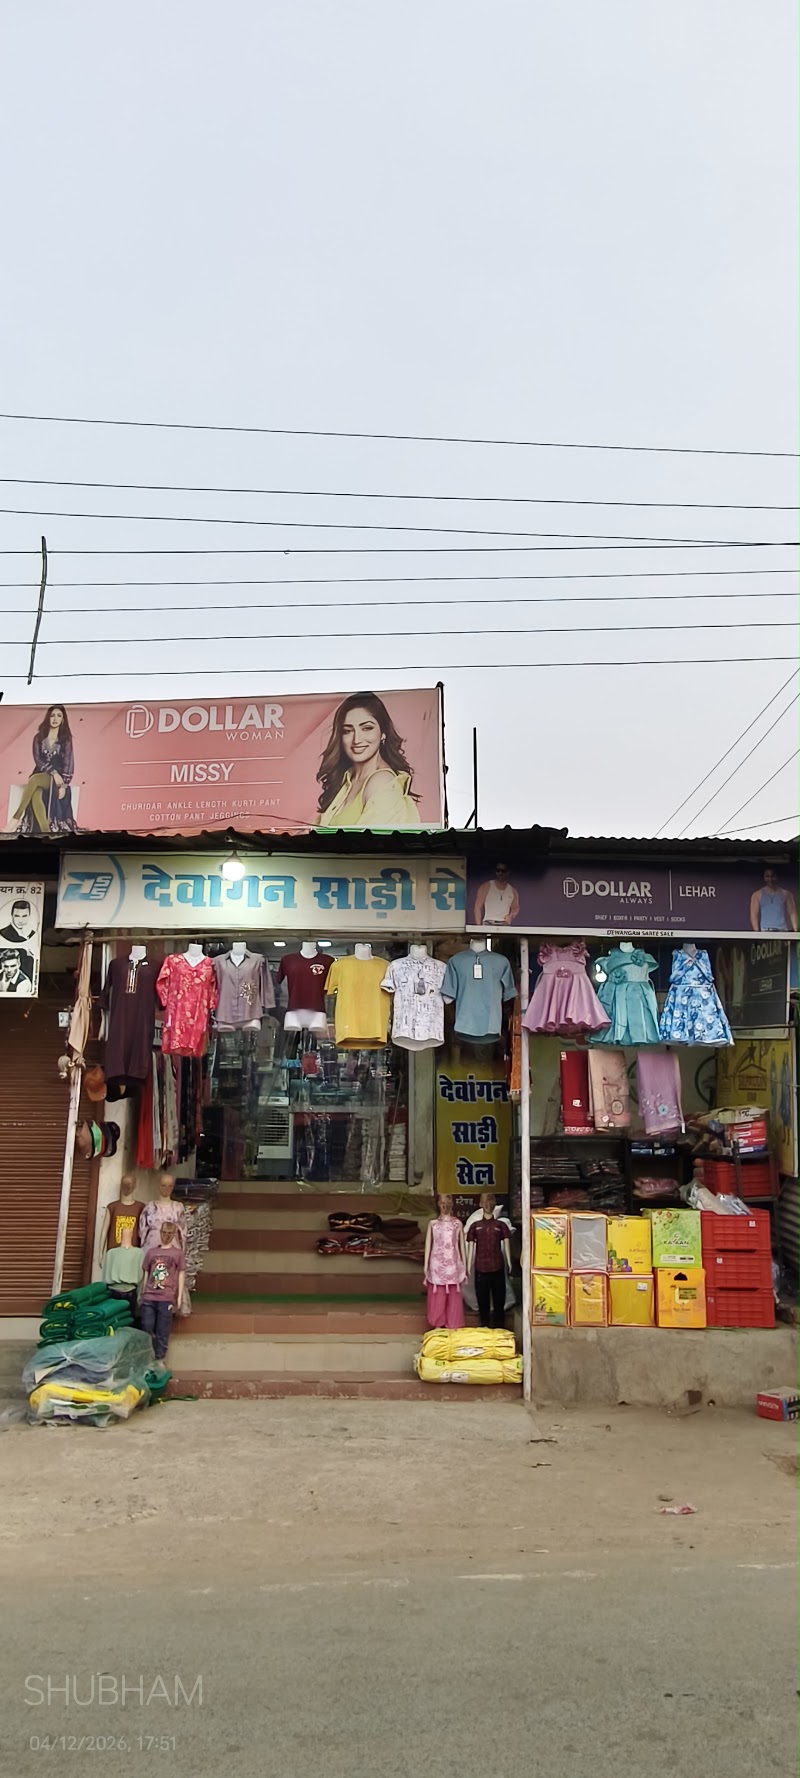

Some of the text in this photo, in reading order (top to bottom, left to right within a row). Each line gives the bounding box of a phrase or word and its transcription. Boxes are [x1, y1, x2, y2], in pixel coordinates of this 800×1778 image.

[158, 703, 285, 733] DOLLAR
[225, 730, 284, 741] WOMAN
[170, 762, 235, 783] MISSY
[121, 799, 281, 811] CHURIDAR ANKLE LENGTH KURTI PANT
[149, 813, 181, 822] COTTON
[184, 812, 205, 821] PANT
[30, 886, 42, 894] 82
[312, 867, 416, 919] साड़ी
[581, 880, 653, 898] DOLLAR
[679, 885, 716, 898] LEHAR
[619, 897, 653, 905] ALWAYS
[438, 1074, 510, 1103] देवांगन
[451, 1115, 498, 1149] साड़ी
[456, 1157, 496, 1186] सेल
